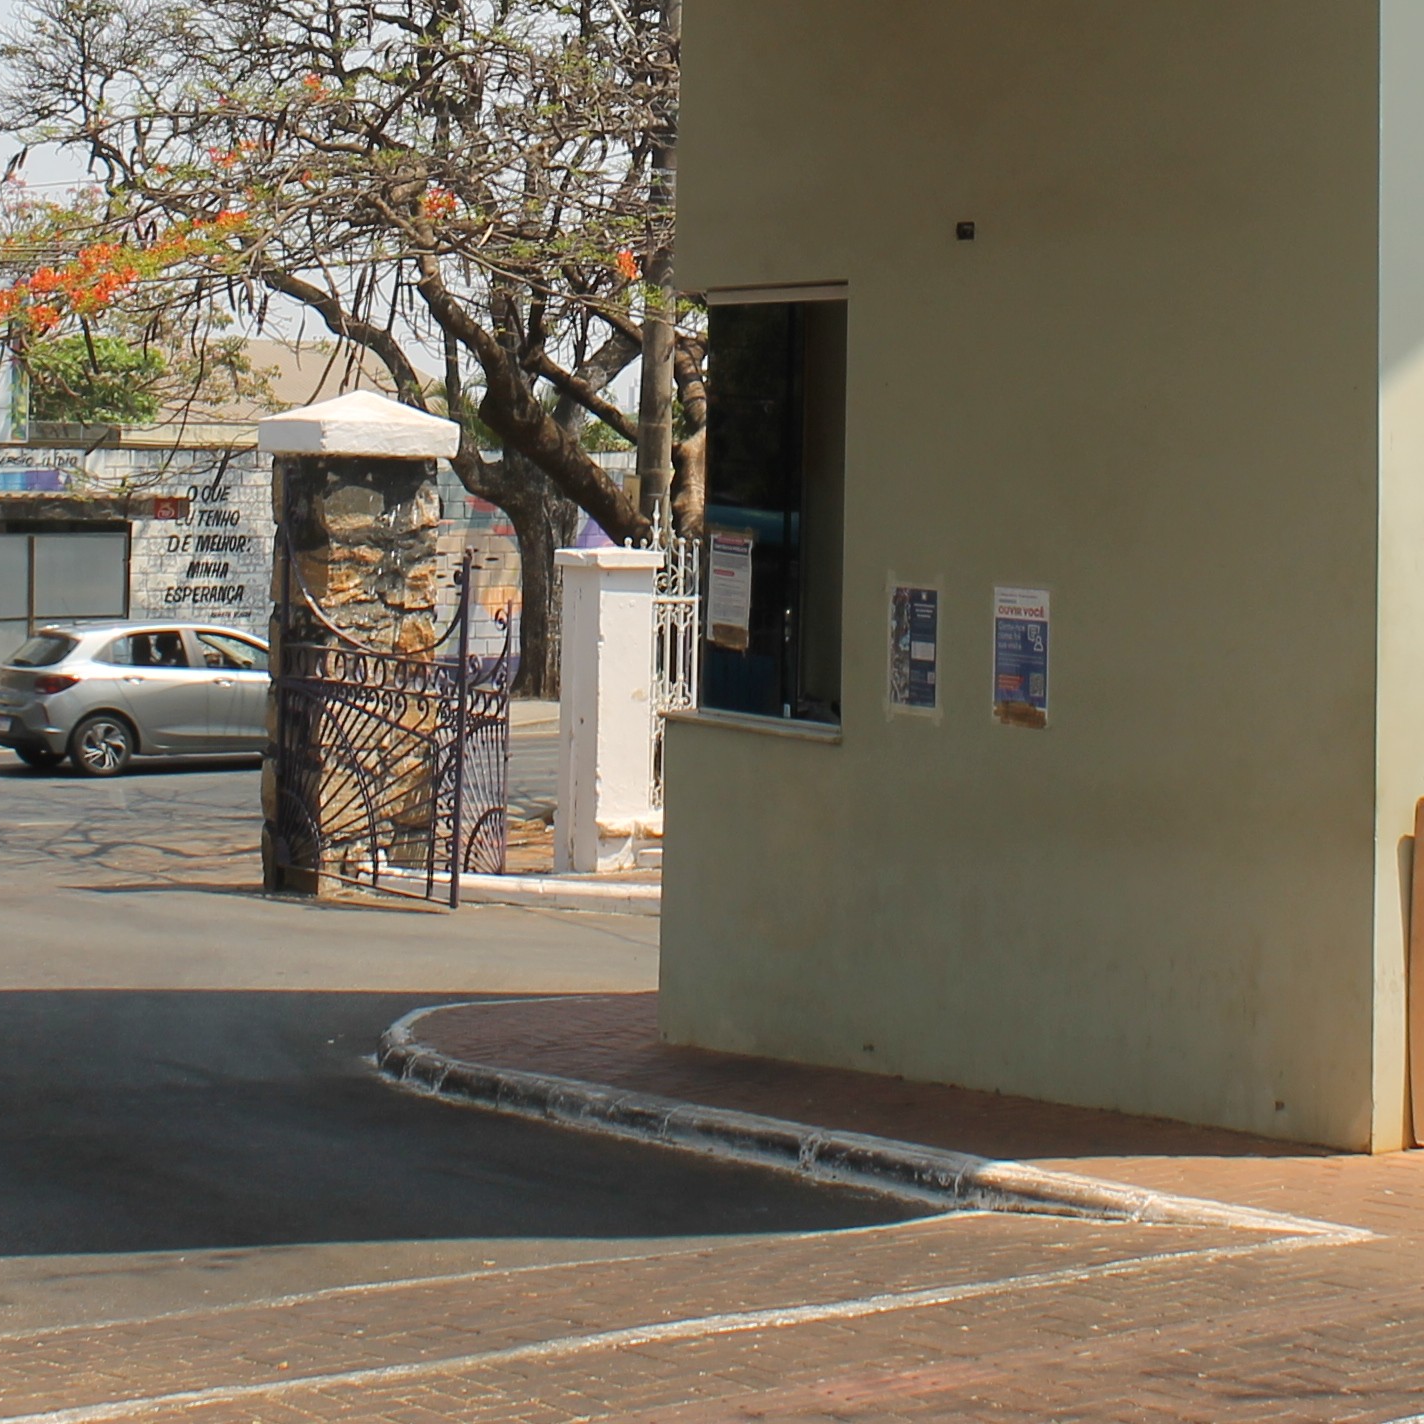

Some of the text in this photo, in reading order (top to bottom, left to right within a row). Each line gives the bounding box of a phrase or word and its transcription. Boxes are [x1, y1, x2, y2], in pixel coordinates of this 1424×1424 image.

[201, 485, 232, 504] QUE
[197, 509, 241, 527] TENHO
[167, 534, 252, 553] DE MELHOR:
[185, 560, 229, 579] MINHA
[164, 584, 245, 605] ESPERANÇA
